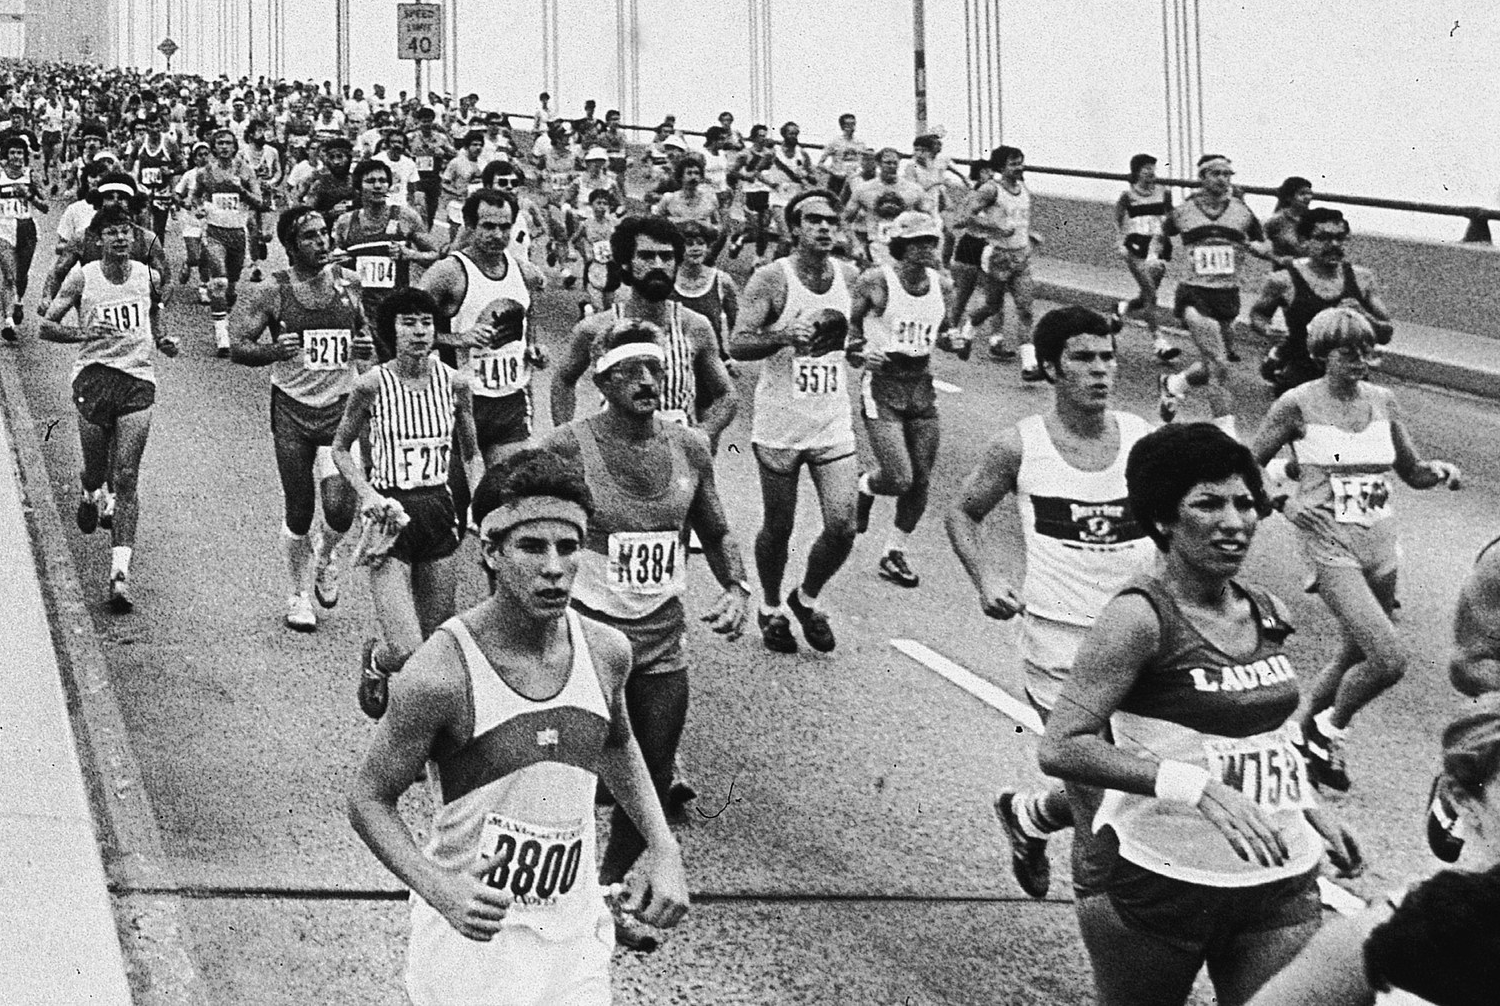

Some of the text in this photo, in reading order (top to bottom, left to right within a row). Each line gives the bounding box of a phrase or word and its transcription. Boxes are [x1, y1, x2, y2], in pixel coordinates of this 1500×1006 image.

[408, 36, 431, 54] 40
[103, 303, 140, 330] 5197
[310, 336, 348, 364] 6273
[798, 365, 838, 394] 5573
[484, 833, 582, 899] 3800
